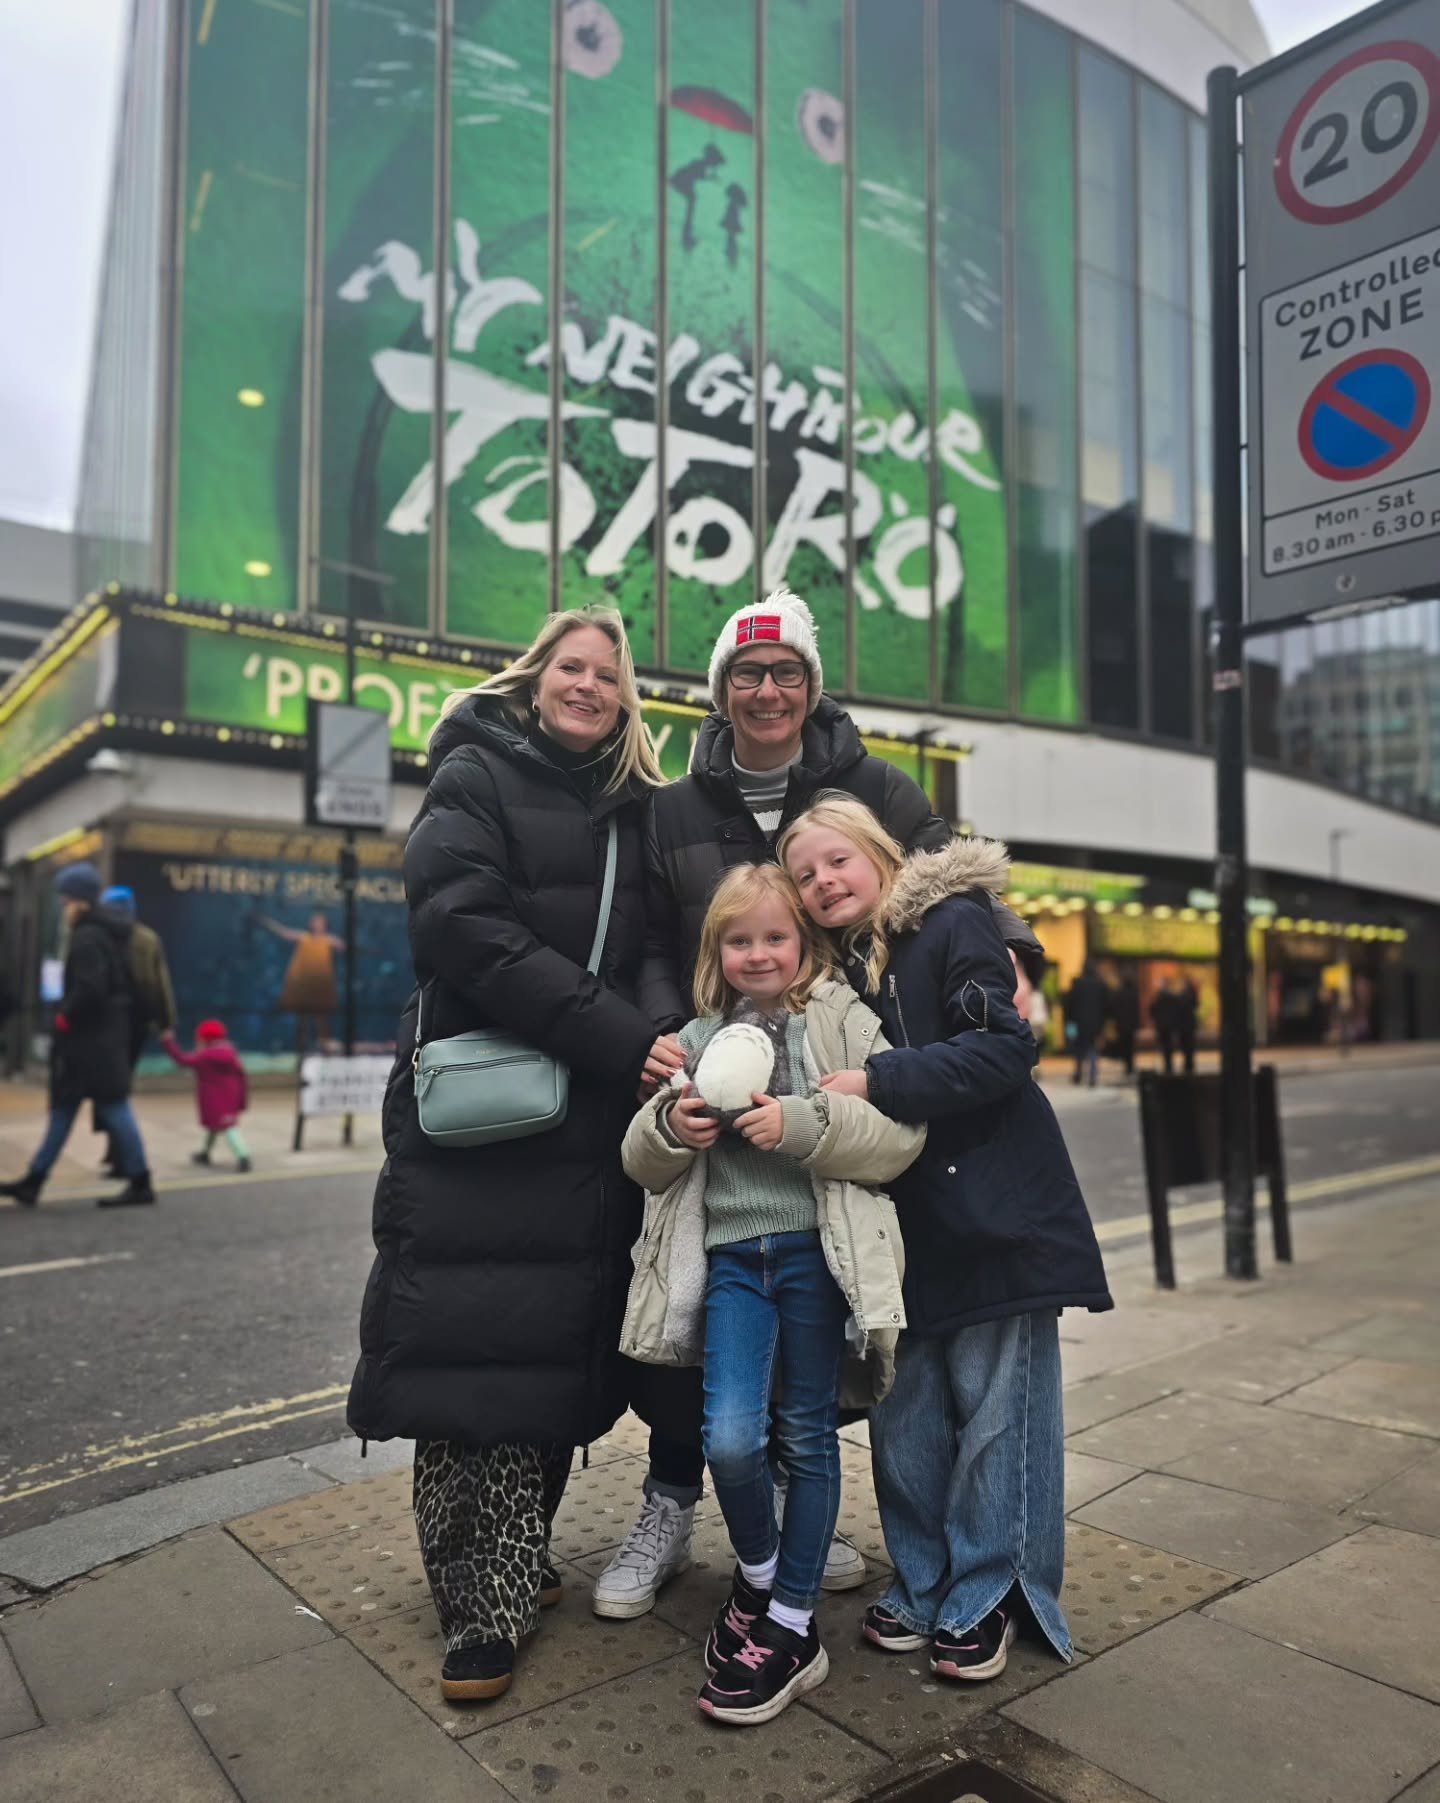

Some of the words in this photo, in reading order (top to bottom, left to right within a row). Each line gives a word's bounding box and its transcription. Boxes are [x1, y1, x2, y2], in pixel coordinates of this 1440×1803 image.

[1301, 81, 1418, 189] 20
[339, 218, 542, 352] MY
[526, 315, 1000, 491] NEIGHBOUR
[1300, 288, 1424, 361] ZONE
[371, 348, 963, 620] TOTORO
[1315, 507, 1359, 530] Mon
[1377, 489, 1416, 513] Sat
[1273, 538, 1320, 563] 8.30
[1325, 532, 1356, 550] am
[1373, 511, 1425, 538] 6.30
